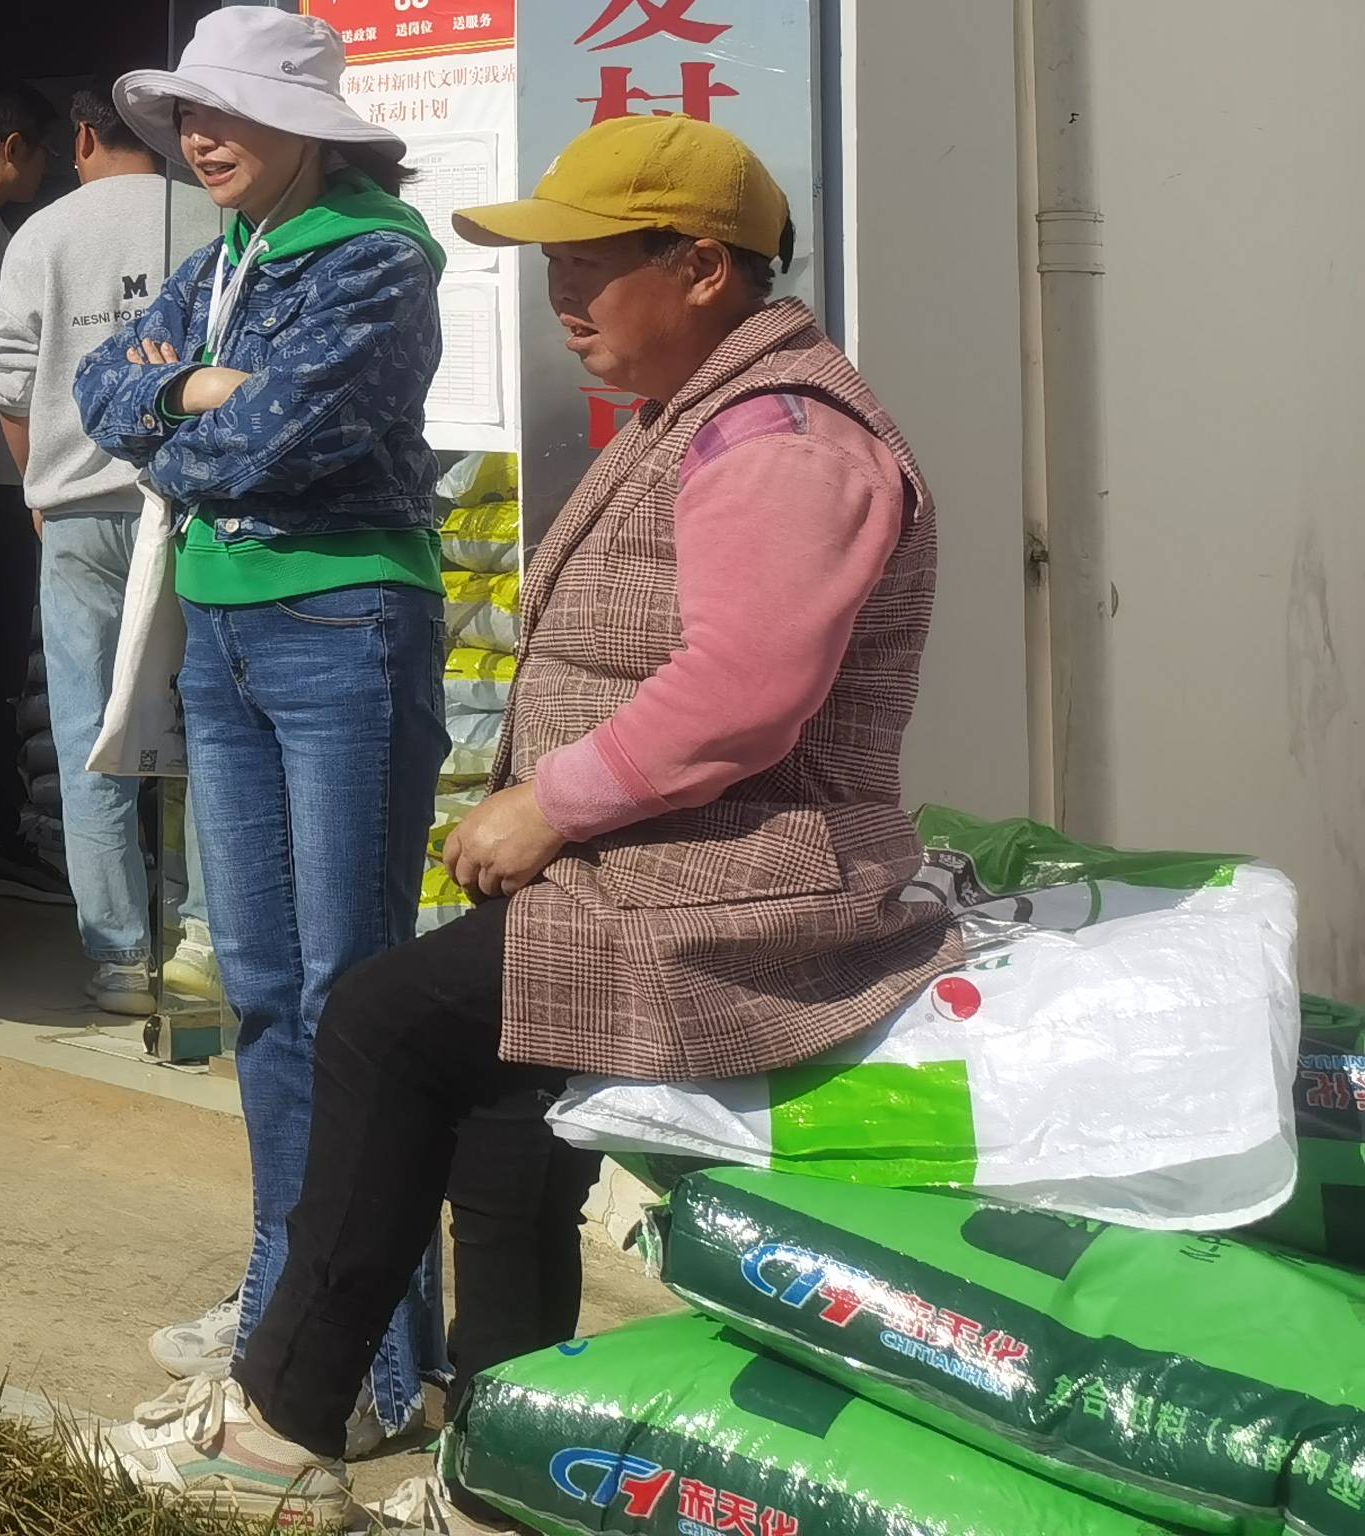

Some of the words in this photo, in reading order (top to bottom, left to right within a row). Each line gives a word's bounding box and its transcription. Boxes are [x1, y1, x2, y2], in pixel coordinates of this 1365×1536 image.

[341, 27, 377, 43] 送政策
[395, 20, 433, 38] 送岗位
[452, 13, 492, 31] 送服务
[347, 64, 516, 95] 海发村新时代文明实践站
[369, 98, 449, 124] 活动计划
[122, 274, 147, 299] M
